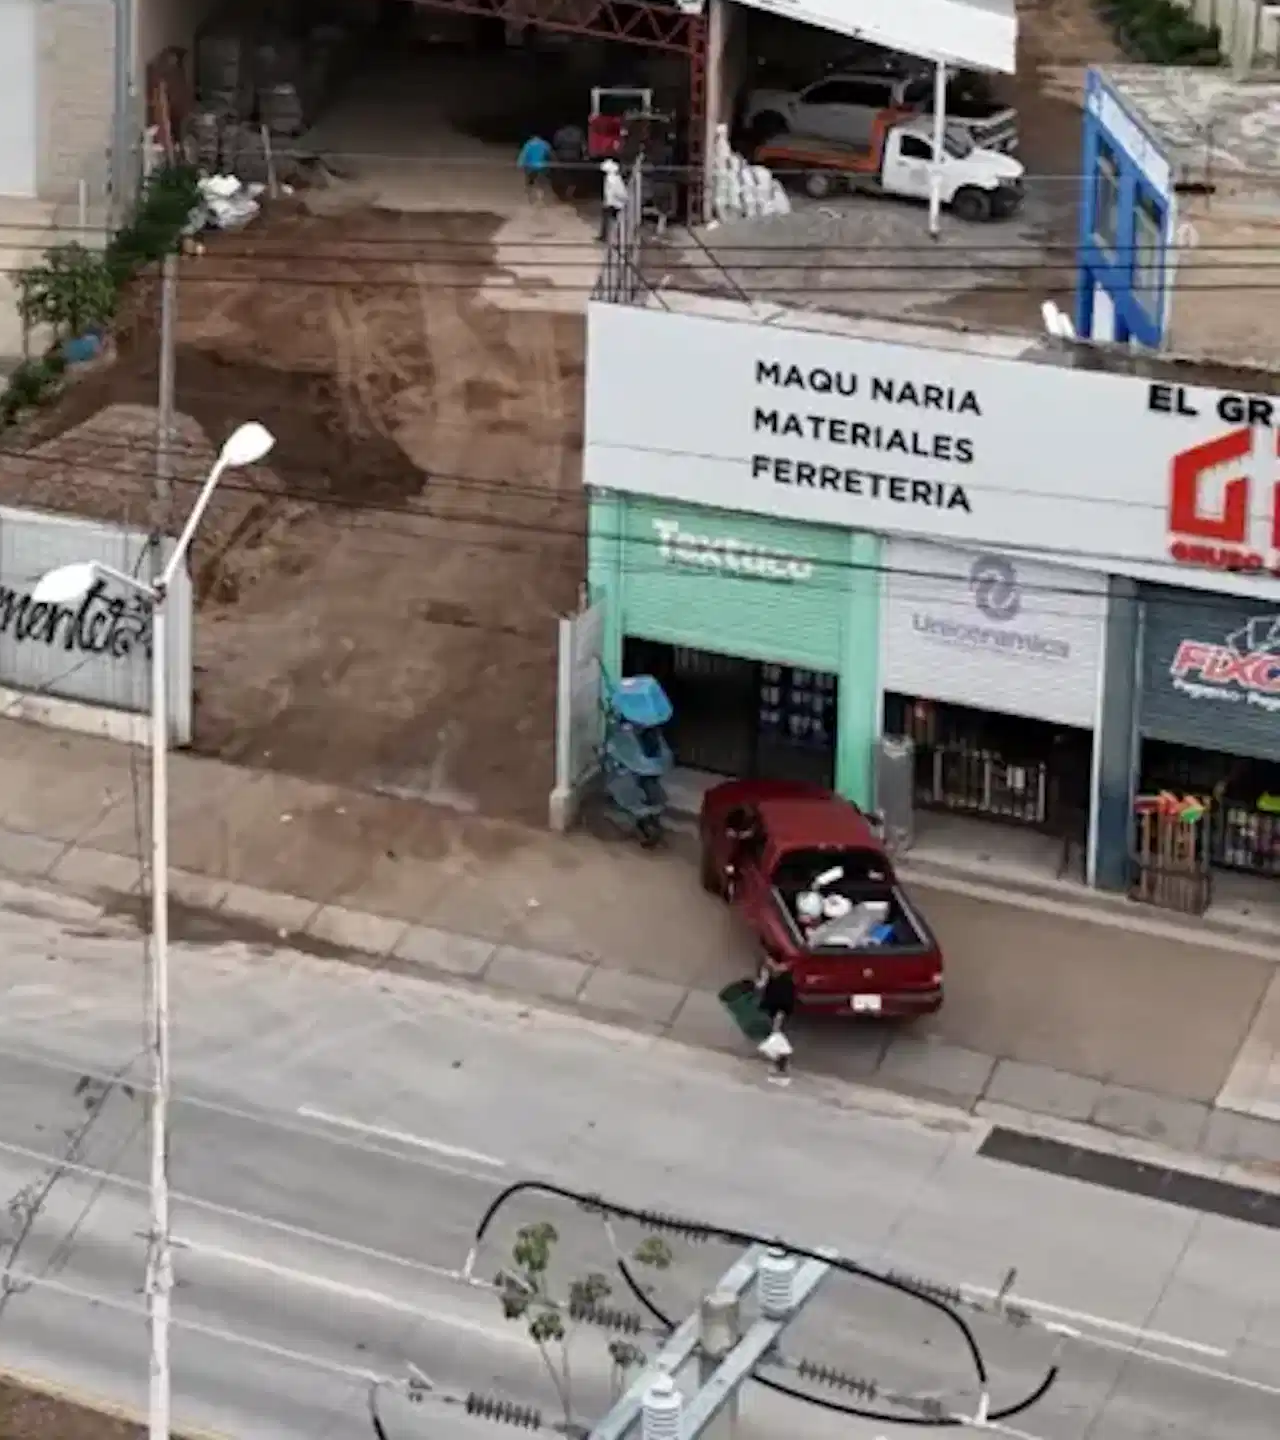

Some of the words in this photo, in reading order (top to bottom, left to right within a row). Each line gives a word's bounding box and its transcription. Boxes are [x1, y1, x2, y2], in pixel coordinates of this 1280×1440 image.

[1148, 384, 1200, 417] EL
[1216, 393, 1275, 427] GR
[753, 406, 974, 464] MATERIALES
[751, 453, 973, 514] FERRETERIA
